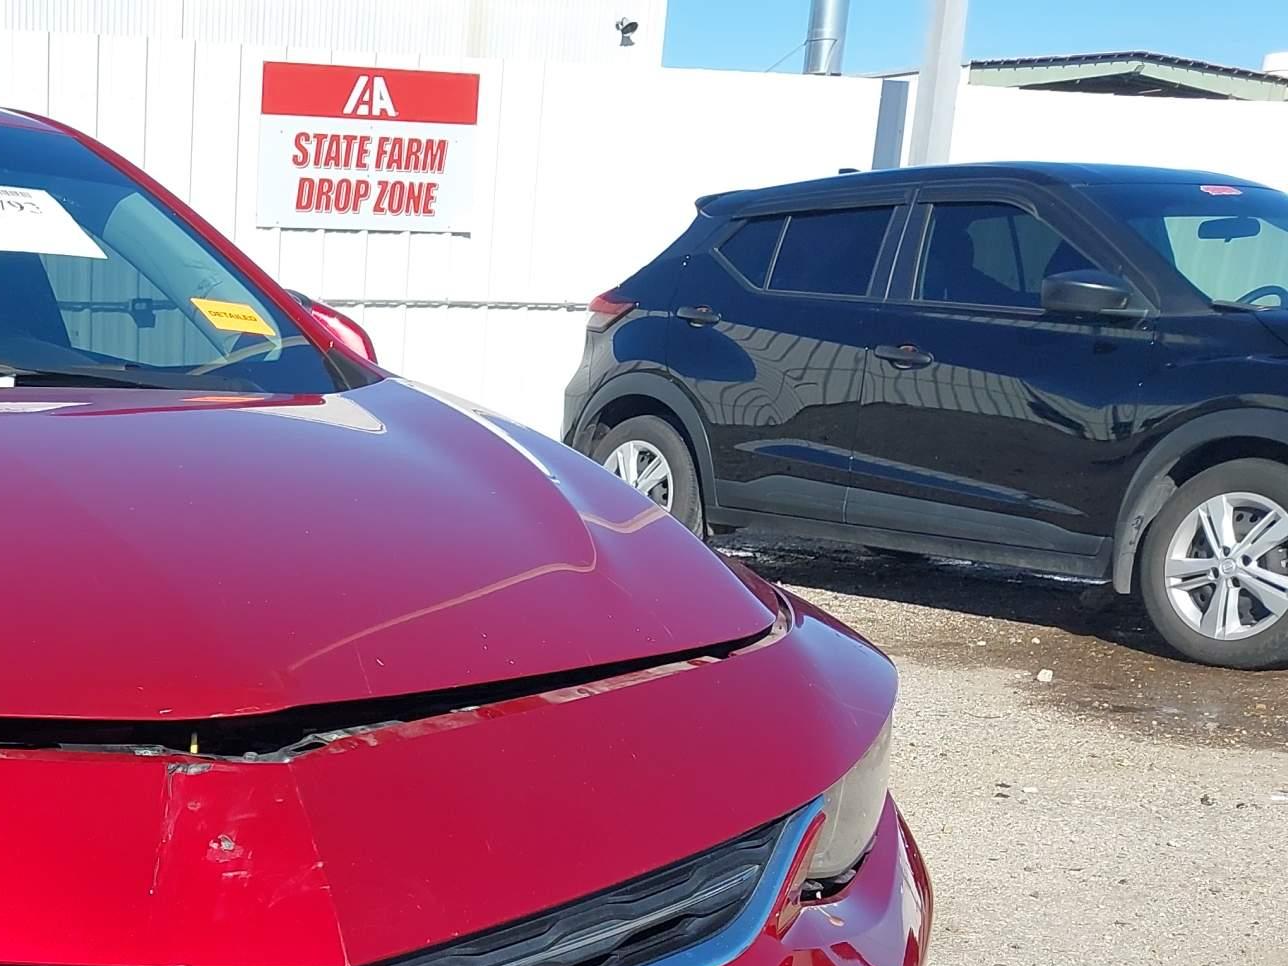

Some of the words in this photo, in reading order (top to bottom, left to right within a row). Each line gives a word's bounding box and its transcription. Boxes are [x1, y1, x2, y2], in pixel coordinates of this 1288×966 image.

[292, 132, 372, 170] STATE
[374, 137, 448, 174] FARM
[295, 177, 371, 214] DROP
[373, 181, 439, 217] ZONE
[207, 310, 258, 322] DETAILED
